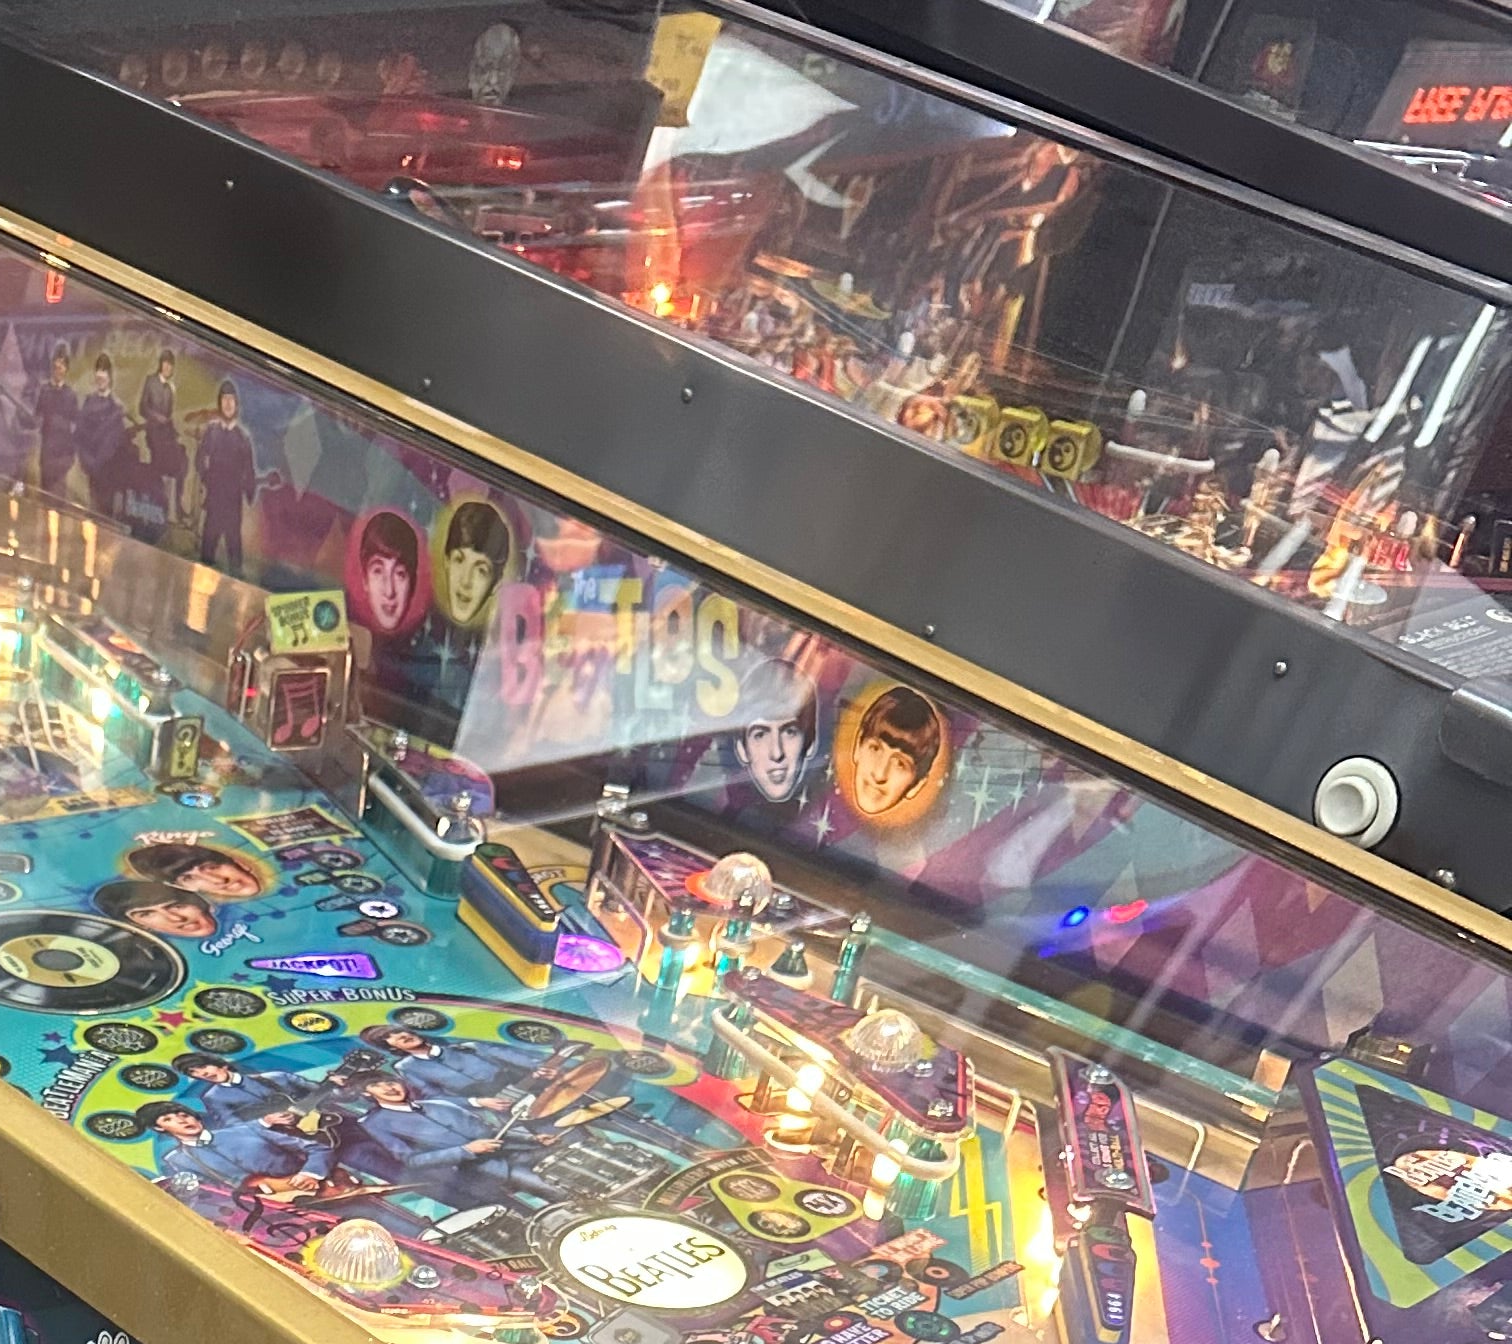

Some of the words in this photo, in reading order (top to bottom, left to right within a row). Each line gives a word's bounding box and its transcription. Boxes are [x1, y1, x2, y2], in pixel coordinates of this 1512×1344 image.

[200, 922, 263, 957] George
[270, 957, 360, 975] JACKPOT!
[268, 989, 338, 1006] SUPER
[342, 987, 417, 1003] BONUS
[577, 1236, 726, 1298] BEATLES
[859, 1287, 908, 1311] TICKET
[871, 1305, 894, 1321] TO
[892, 1292, 926, 1315] RIDE
[1107, 1291, 1124, 1324] 1964
